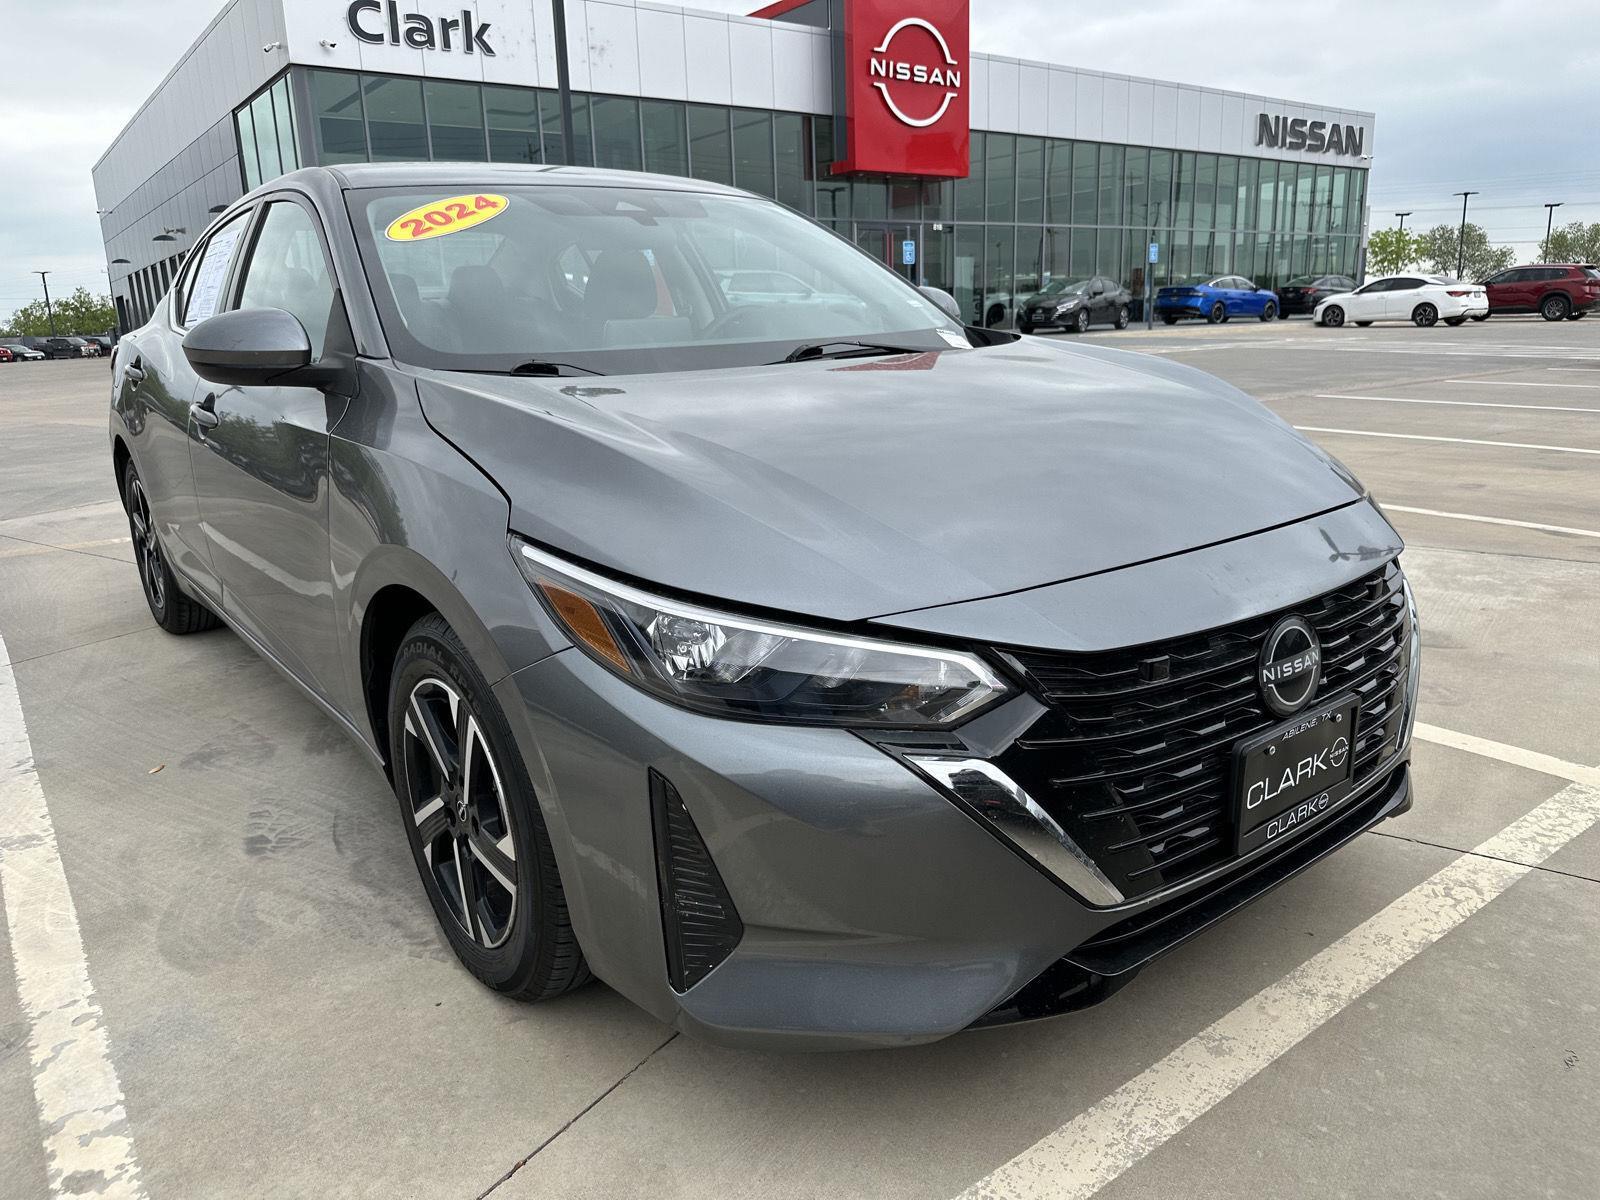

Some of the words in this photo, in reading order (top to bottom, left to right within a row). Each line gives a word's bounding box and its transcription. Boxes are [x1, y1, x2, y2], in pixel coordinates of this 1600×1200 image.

[347, 0, 496, 57] Clark
[870, 57, 961, 88] NISSAN
[1256, 113, 1364, 157] NISSAN
[400, 195, 498, 238] 2024
[403, 641, 443, 664] RADIAL
[1262, 650, 1319, 685] NISSAN
[1321, 710, 1333, 722] TX
[1246, 748, 1329, 810] CLARK
[1330, 744, 1350, 760] NISSAN
[1266, 798, 1318, 840] CLARK
